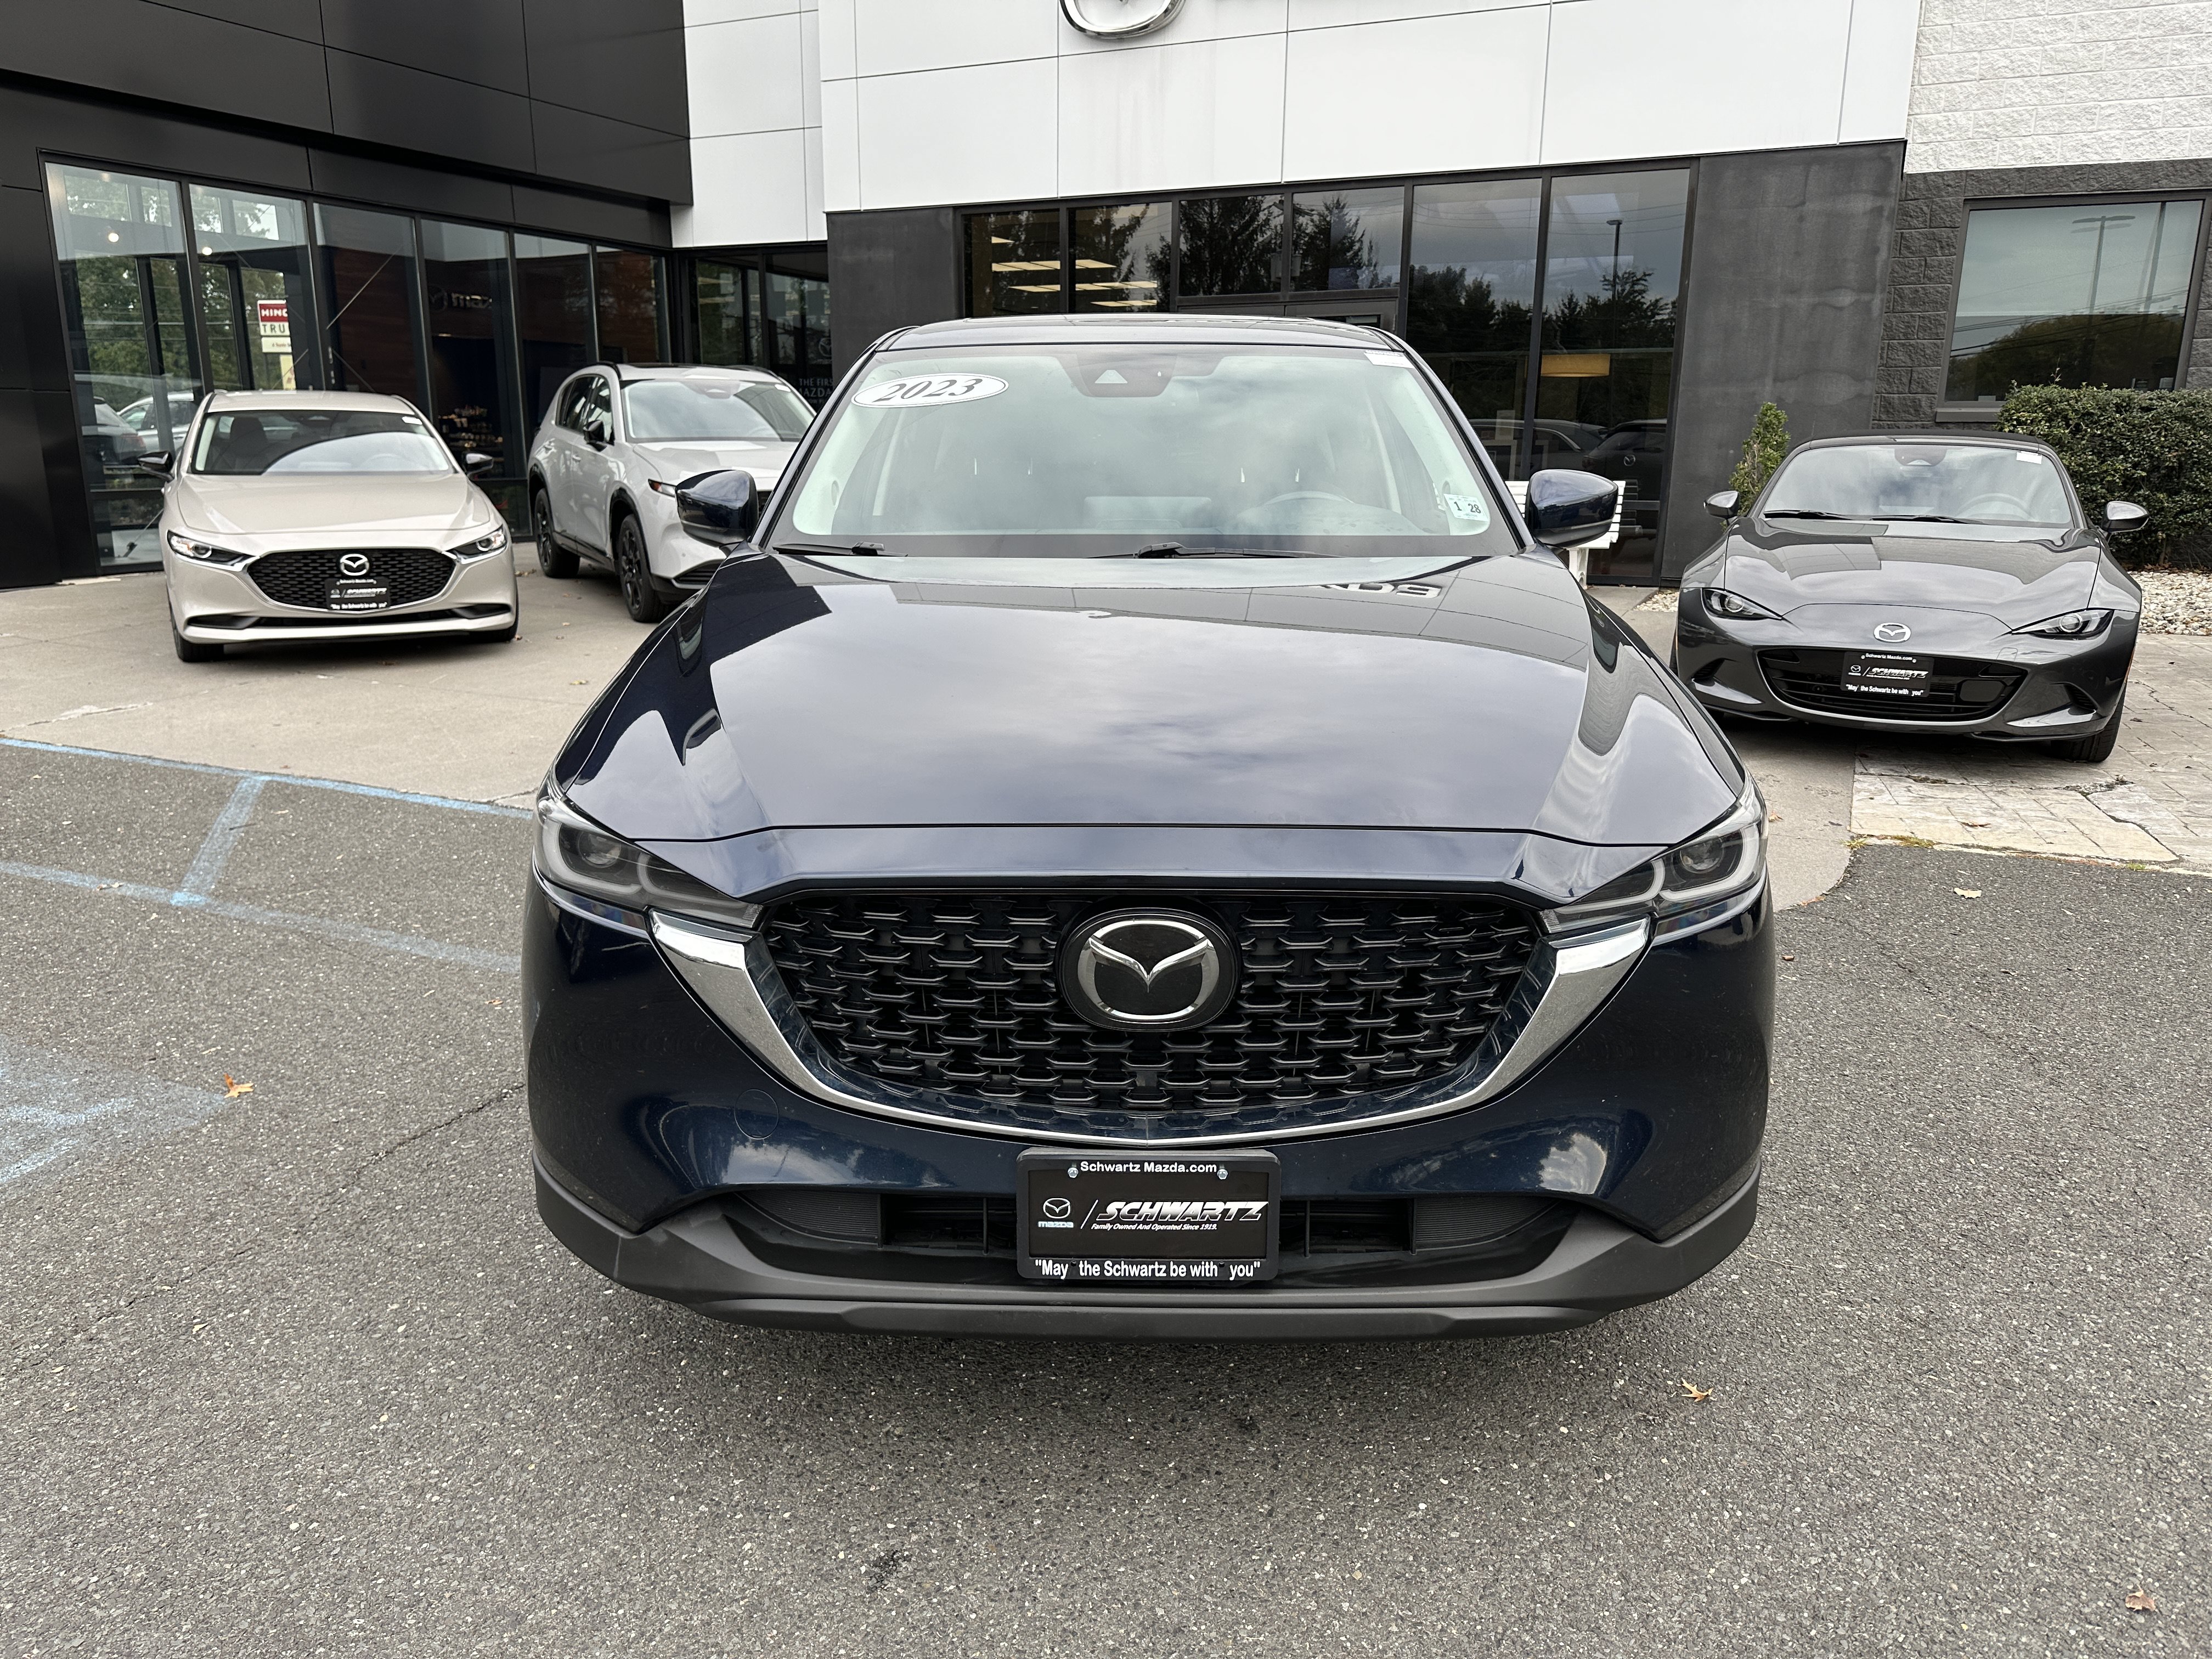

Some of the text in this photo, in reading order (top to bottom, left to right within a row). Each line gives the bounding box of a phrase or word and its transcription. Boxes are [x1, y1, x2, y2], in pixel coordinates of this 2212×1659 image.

[262, 324, 286, 334] TRU
[799, 378, 815, 387] THE
[871, 378, 983, 403] 2023
[1454, 501, 1481, 514] 1 28
[1868, 668, 1929, 679] SCHWARTZ
[1080, 1161, 1217, 1173] Schwartz Mazda.com
[1096, 1201, 1269, 1221] SCHWARTZ
[1091, 1223, 1114, 1231] Family
[1035, 1259, 1261, 1281] "May the Schwartz be with you"
